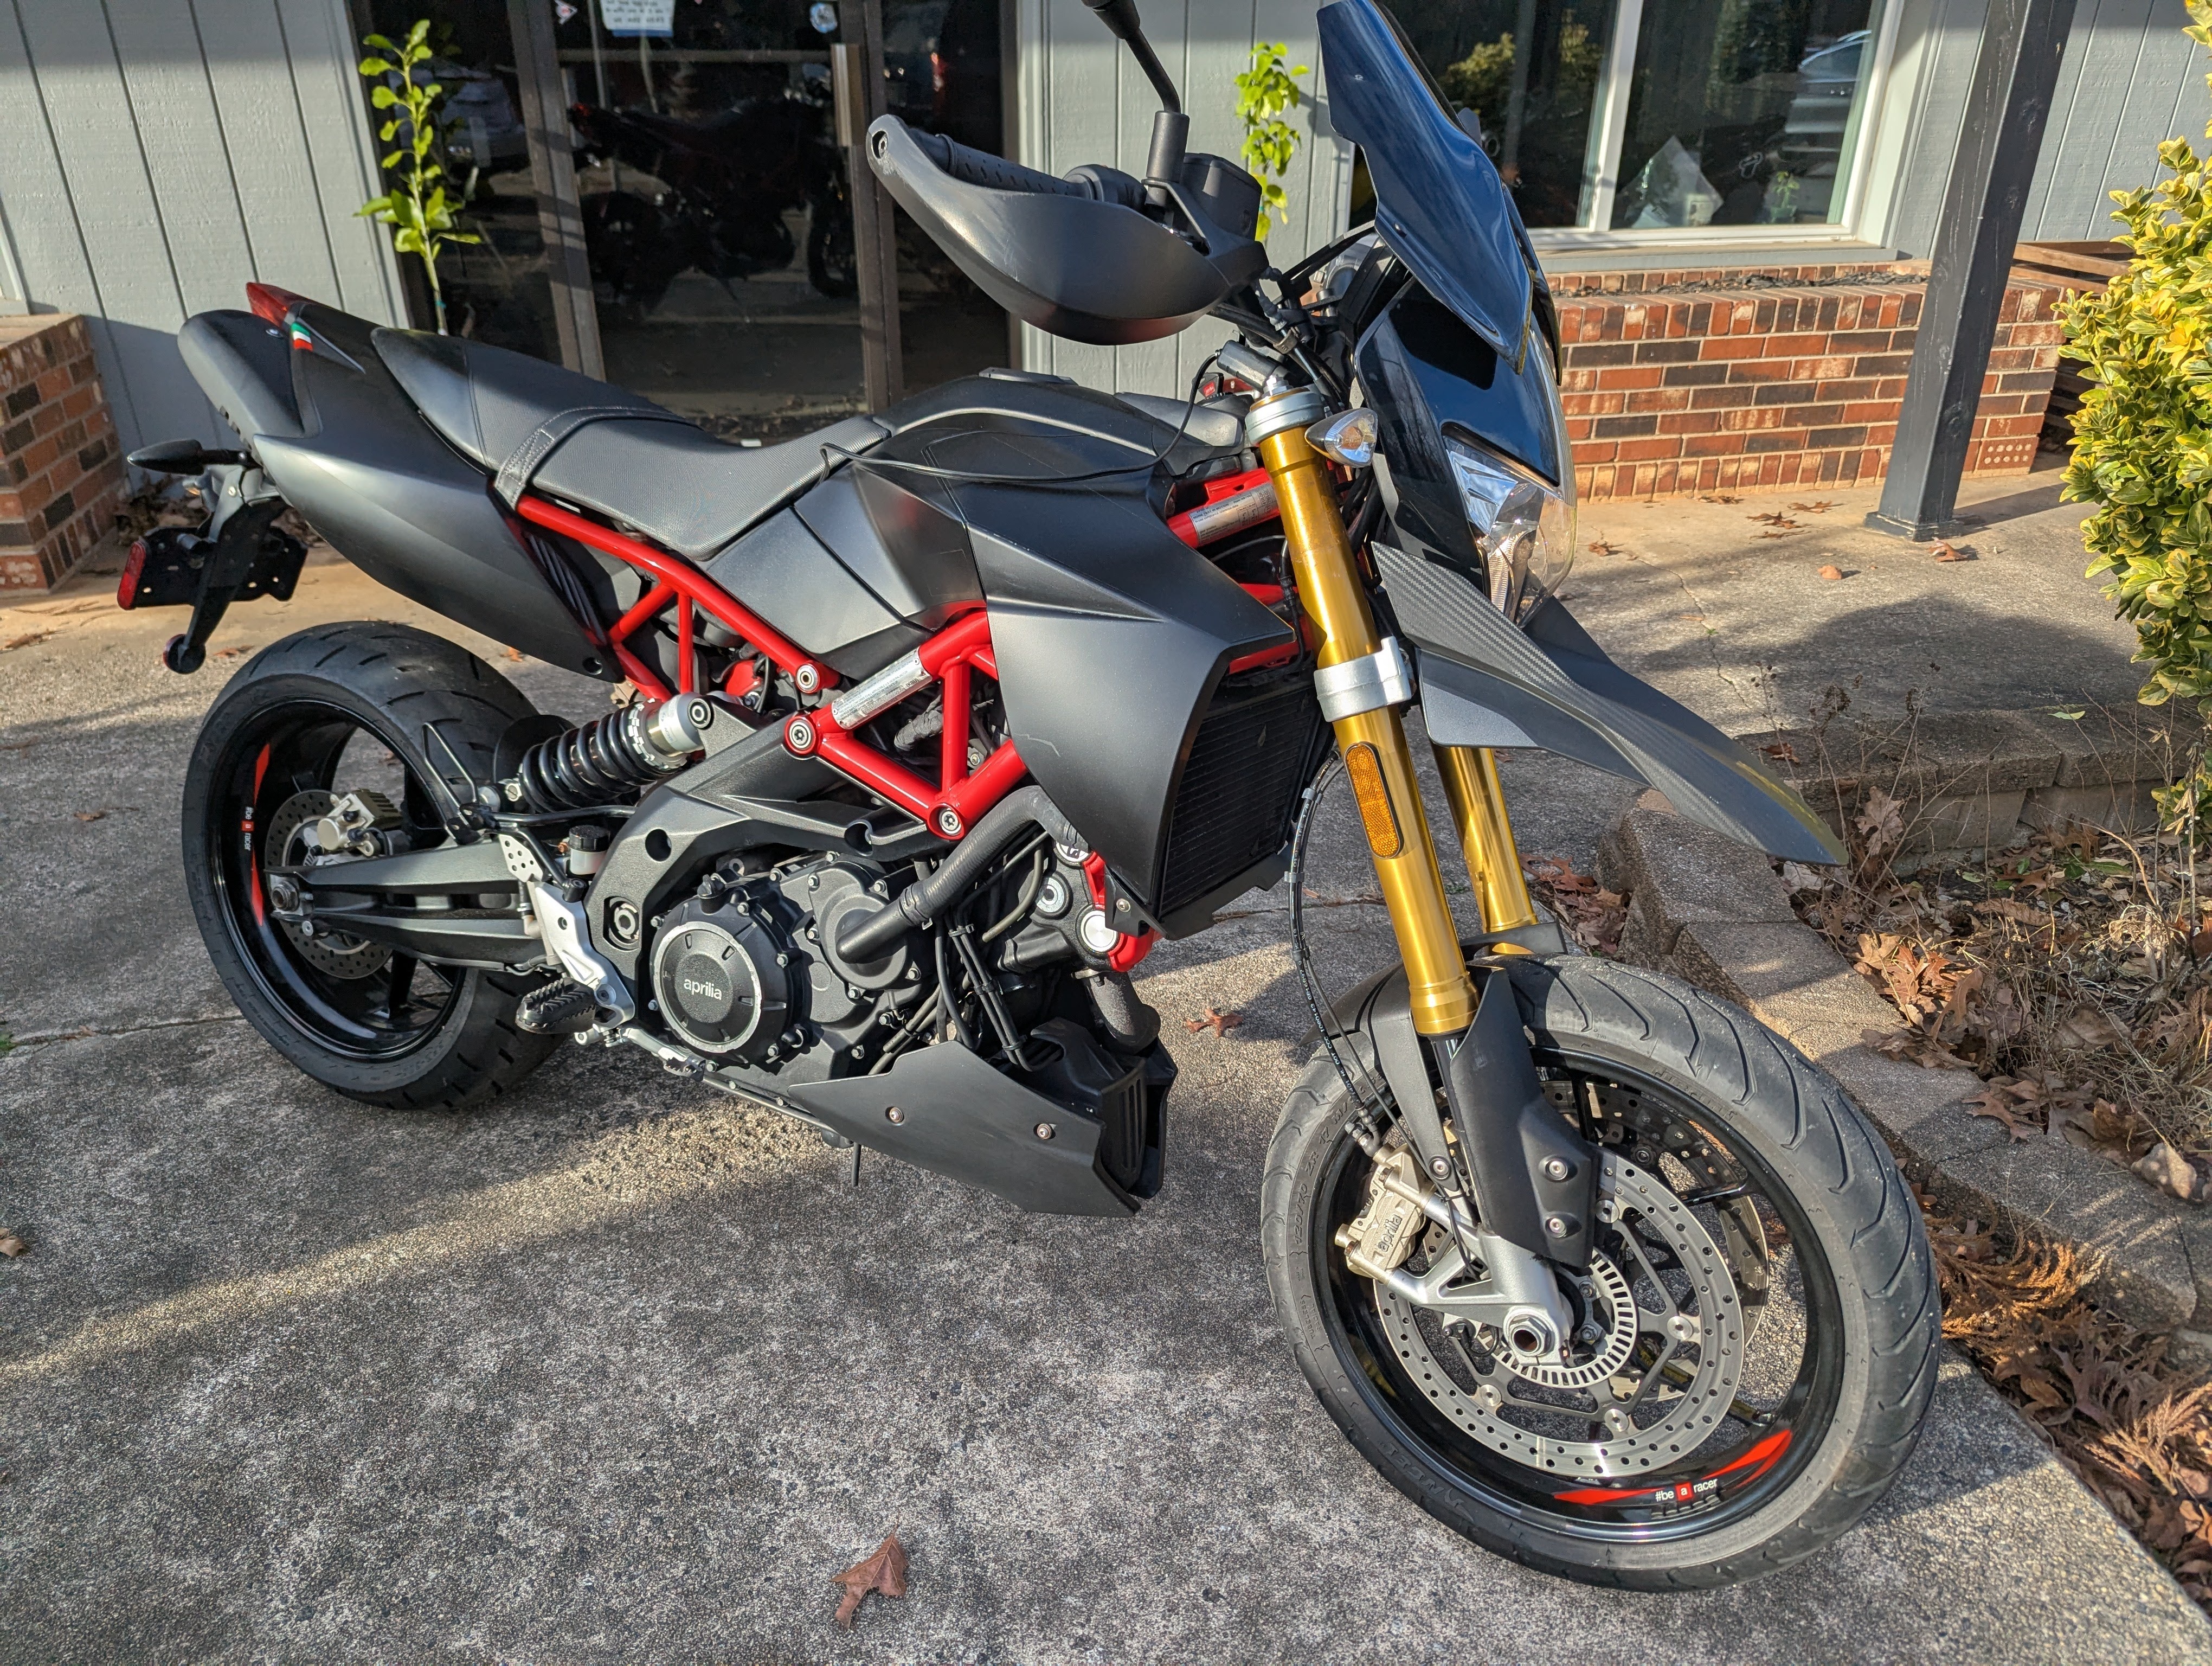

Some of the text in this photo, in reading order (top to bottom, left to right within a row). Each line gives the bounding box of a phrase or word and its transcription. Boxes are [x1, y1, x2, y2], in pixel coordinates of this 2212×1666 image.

[684, 978, 723, 1000] aprilia
[1324, 1036, 1332, 1049] CCC
[1377, 1214, 1403, 1253] aprilia
[1655, 1490, 1674, 1502] #be
[1693, 1477, 1719, 1494] racer
